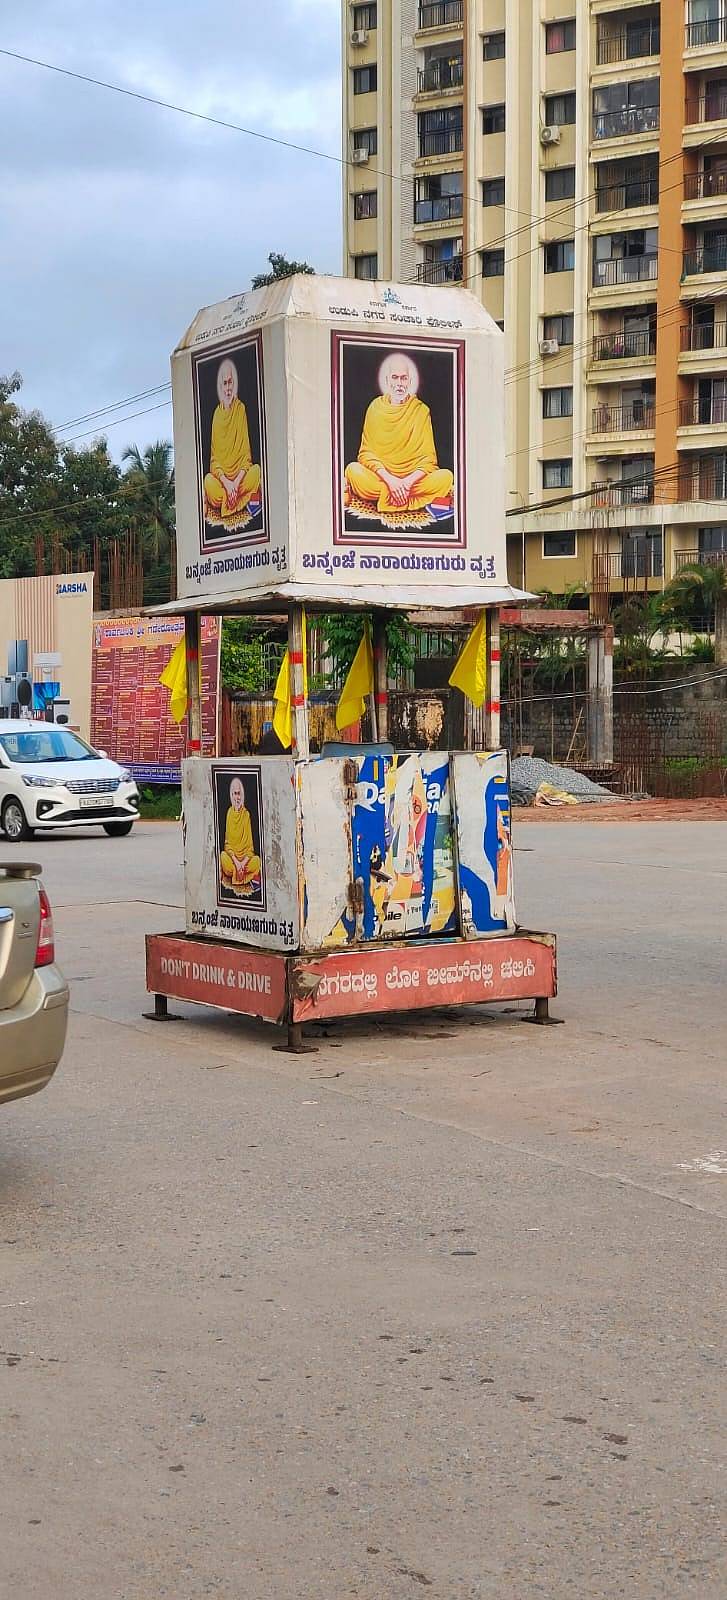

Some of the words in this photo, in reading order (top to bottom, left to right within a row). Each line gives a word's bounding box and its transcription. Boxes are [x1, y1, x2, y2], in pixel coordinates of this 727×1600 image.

[328, 305, 359, 316] ಉಡುಪಿ
[362, 310, 386, 320] ನಗರ
[185, 558, 212, 584] ಬನ್ನಂಜೆ
[213, 548, 270, 575] ನಾರಾಯಣಗುರು
[271, 545, 288, 571] ವೃತ್ತ
[302, 551, 356, 576] ಬನ್ನಂಜೆ
[359, 553, 466, 572] ನಾರಾಯಣಗುರು
[469, 555, 496, 579] ವೃತ್ತ
[191, 910, 219, 931] ಬನ್ನಂಜೆ
[220, 914, 278, 936] ನಾರಾಯಣಗುರು
[279, 920, 295, 945] ವೃತ್ತ
[160, 956, 190, 979] DON'T
[192, 962, 225, 985] DRINK
[226, 968, 236, 988] &
[237, 971, 272, 995] DRIVE
[385, 965, 419, 990] ಲೋ
[500, 957, 536, 980] ಚಲಿಸಿ
